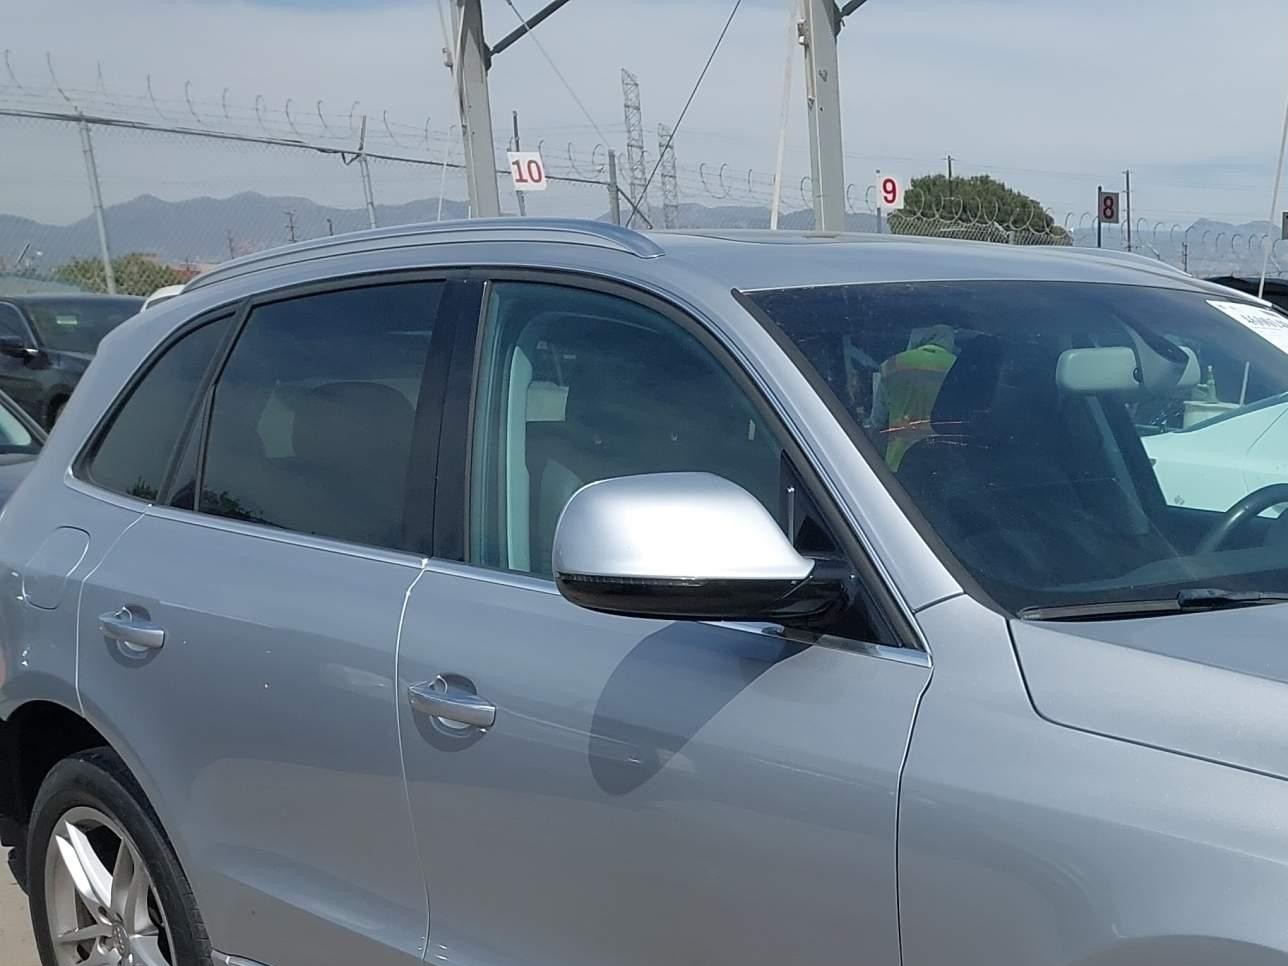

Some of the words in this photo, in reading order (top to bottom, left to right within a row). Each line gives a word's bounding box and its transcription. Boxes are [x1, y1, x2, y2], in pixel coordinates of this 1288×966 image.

[512, 160, 543, 183] 10
[882, 178, 897, 205] 9
[1102, 195, 1115, 220] 8
